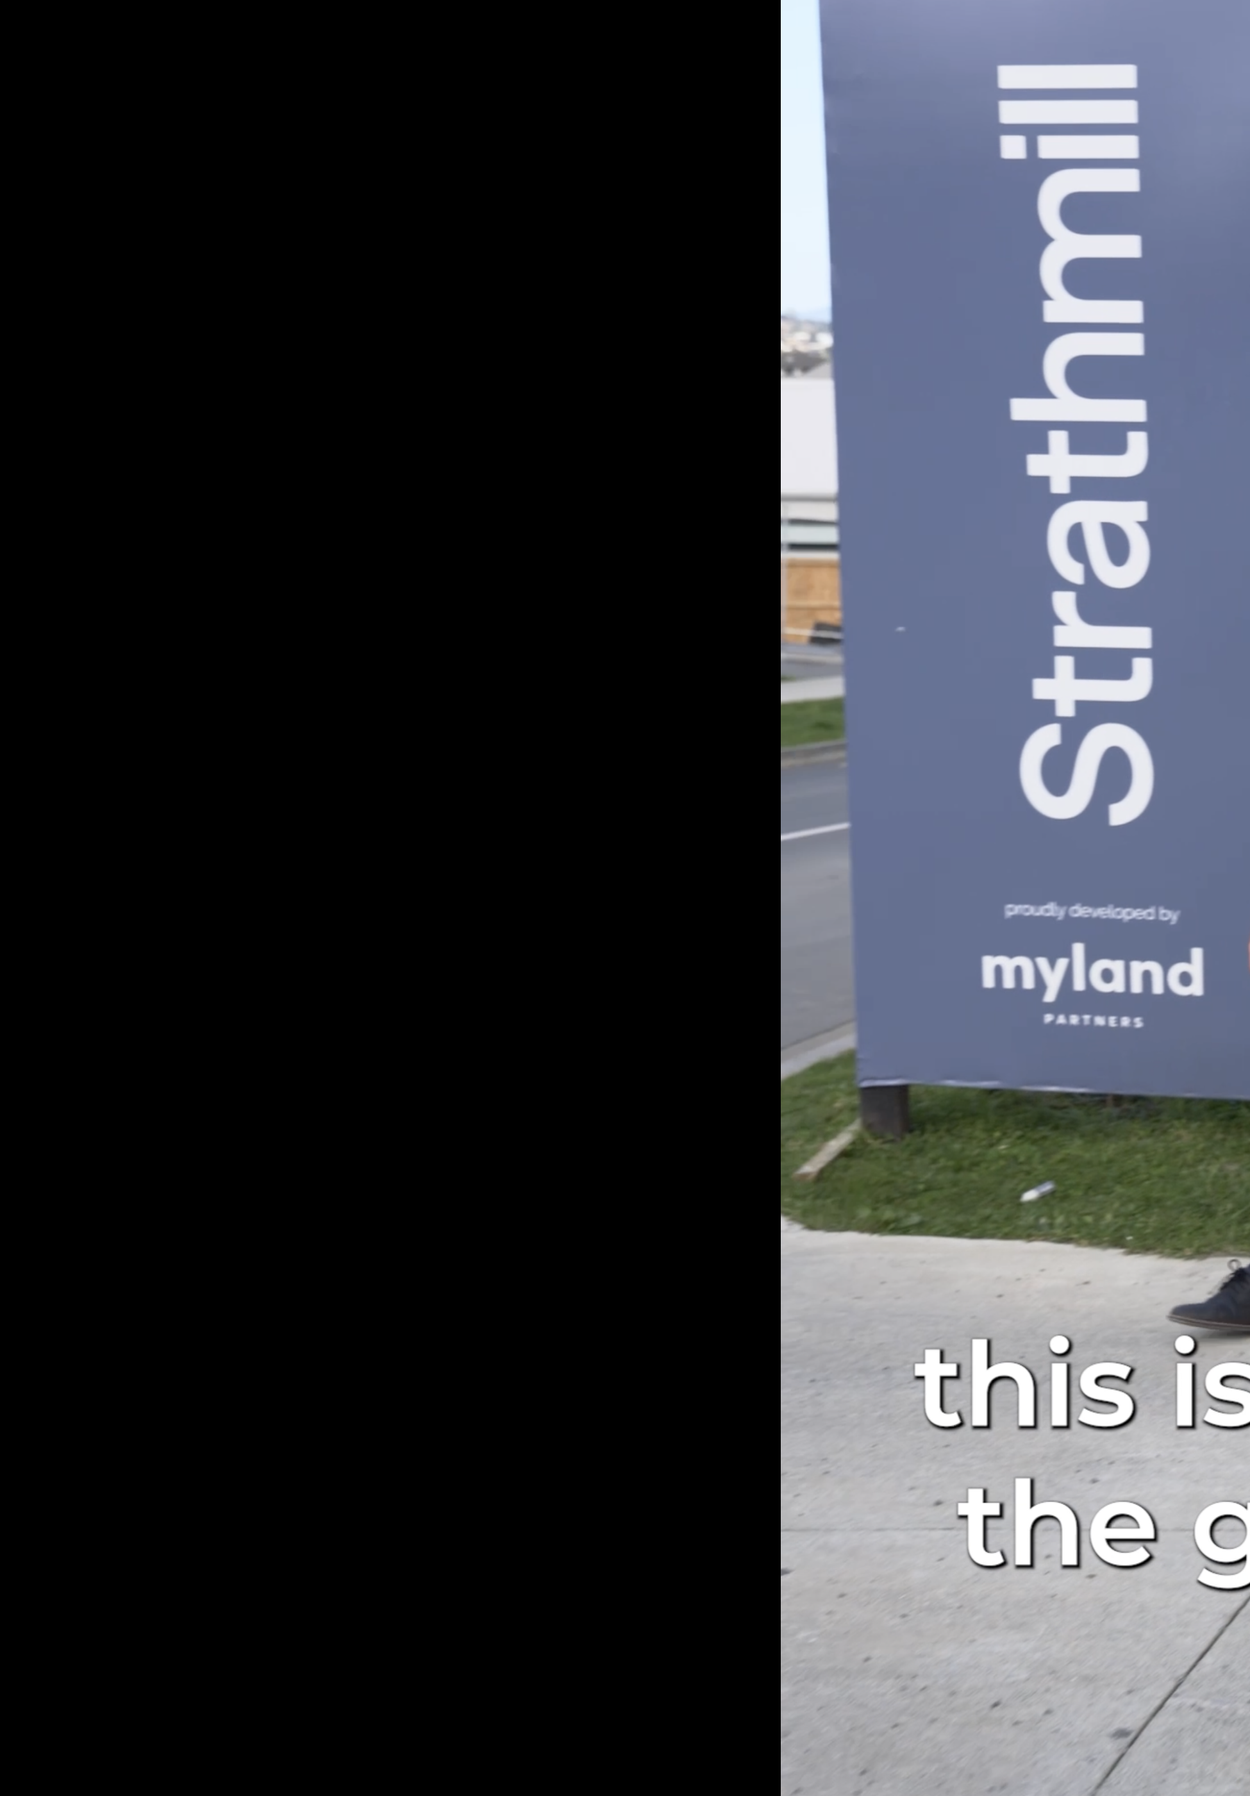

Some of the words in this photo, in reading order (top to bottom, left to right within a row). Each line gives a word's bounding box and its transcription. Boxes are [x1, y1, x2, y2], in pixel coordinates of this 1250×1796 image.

[997, 64, 1154, 827] Strathmill
[1004, 901, 1067, 921] proudly
[1069, 902, 1156, 923] developed
[1157, 906, 1181, 925] by
[980, 942, 1205, 1003] myland
[1042, 1012, 1145, 1029] PARTNERS
